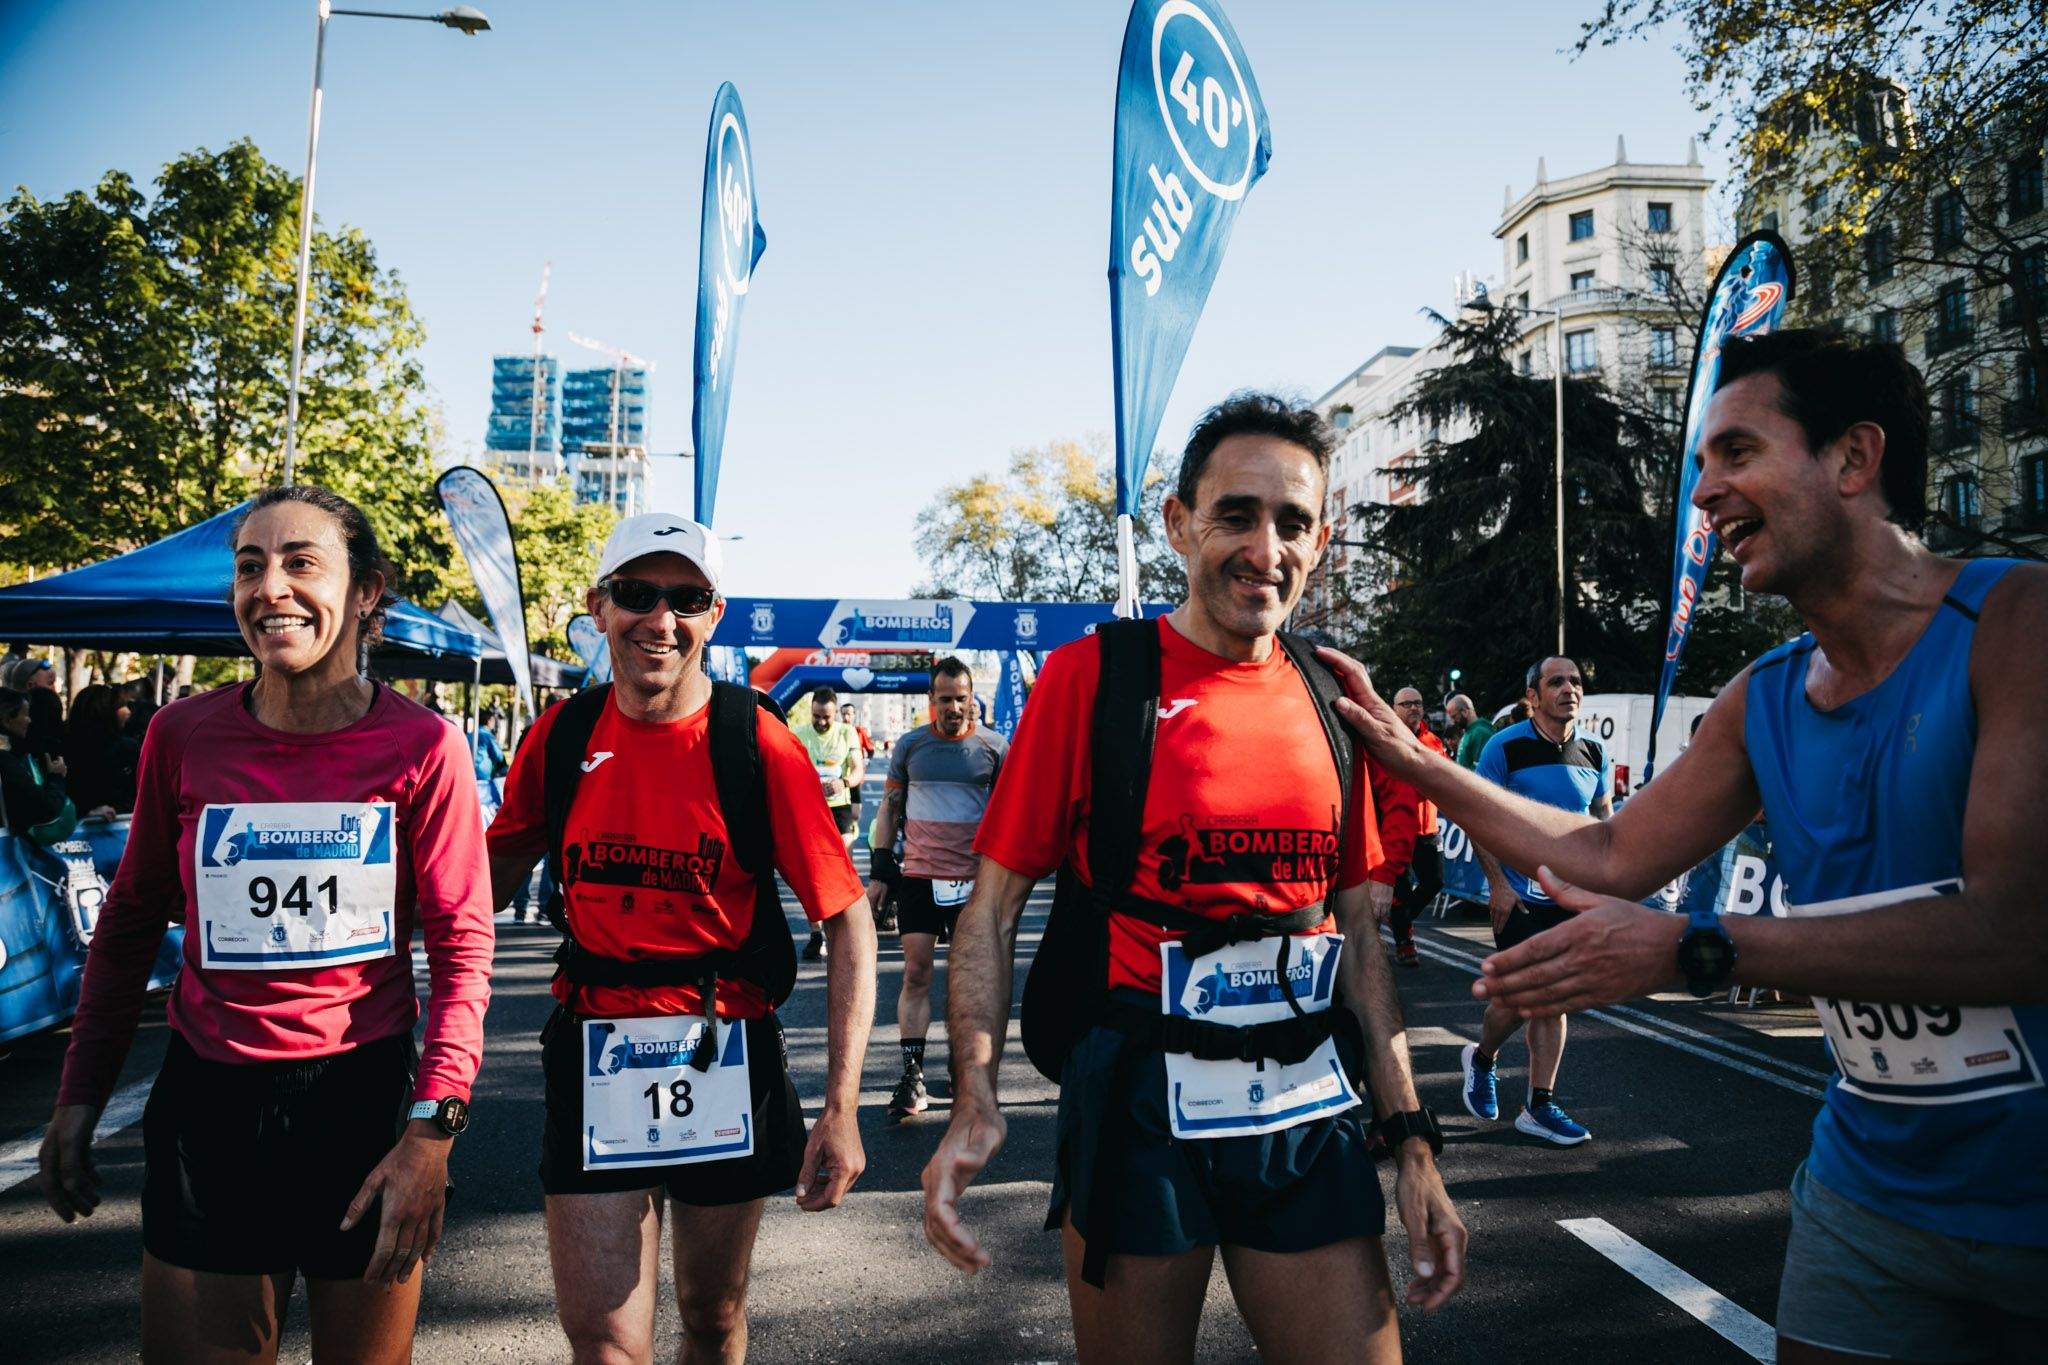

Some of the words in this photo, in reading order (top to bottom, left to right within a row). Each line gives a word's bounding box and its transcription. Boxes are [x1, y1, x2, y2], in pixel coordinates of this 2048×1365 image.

[1131, 163, 1193, 297] sub
[1170, 51, 1242, 148] 40'
[865, 616, 950, 629] BOMBEROS
[259, 830, 359, 844] BOMBEROS
[296, 844, 310, 858] de
[314, 843, 359, 858] MADRID
[1209, 831, 1338, 855] BOMBERO
[594, 844, 716, 875] BOMBEROS
[642, 867, 658, 887] de
[248, 875, 339, 918] 941
[1826, 996, 1962, 1041] 1509
[643, 1079, 695, 1120] 18
